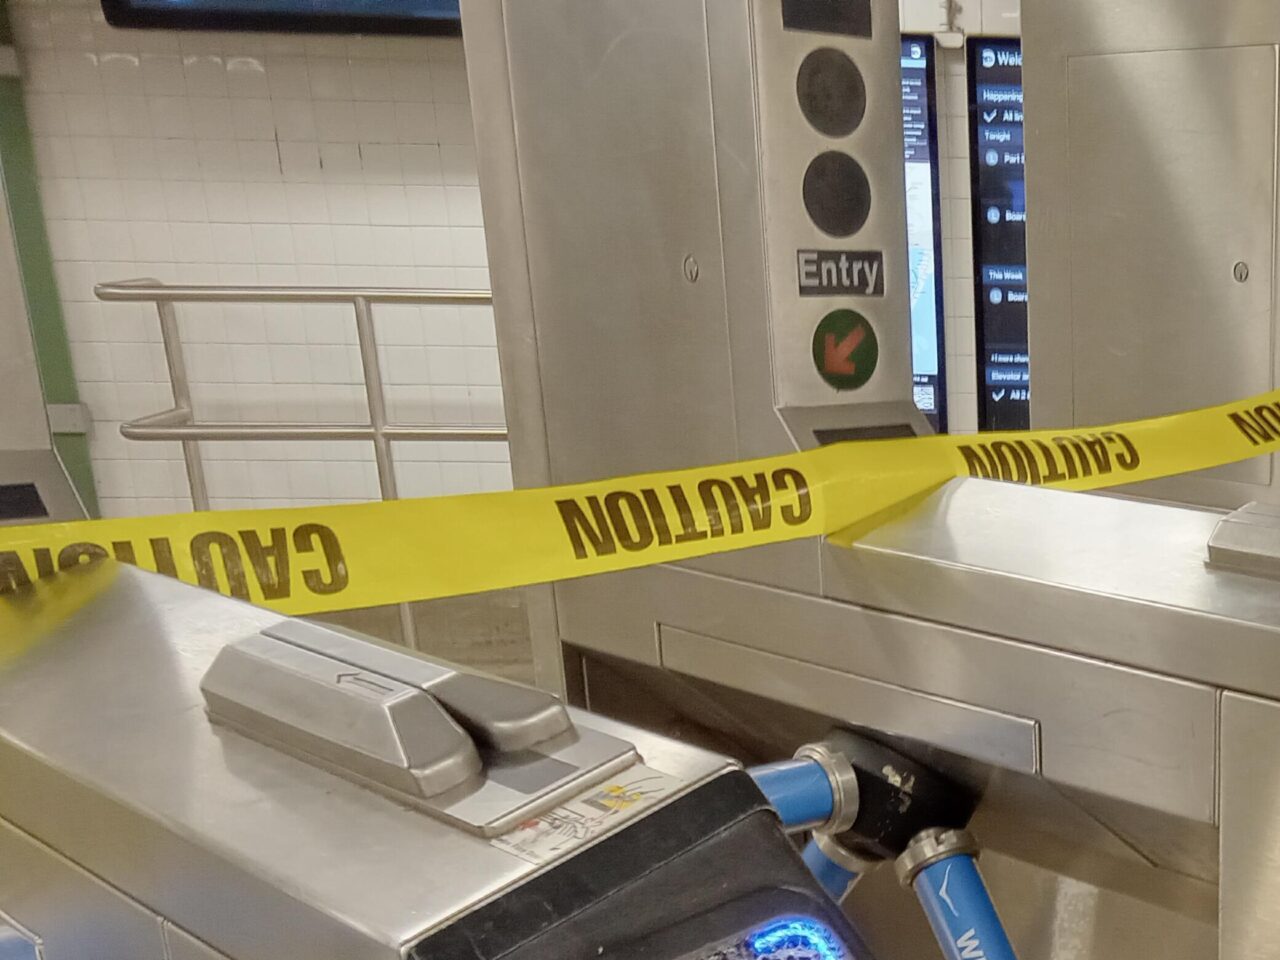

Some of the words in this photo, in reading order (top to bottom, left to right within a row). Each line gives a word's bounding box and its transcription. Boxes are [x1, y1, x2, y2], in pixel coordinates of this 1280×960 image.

[799, 252, 879, 294] Entry
[957, 430, 1140, 485] CAUTION
[555, 468, 812, 560] CAUTION
